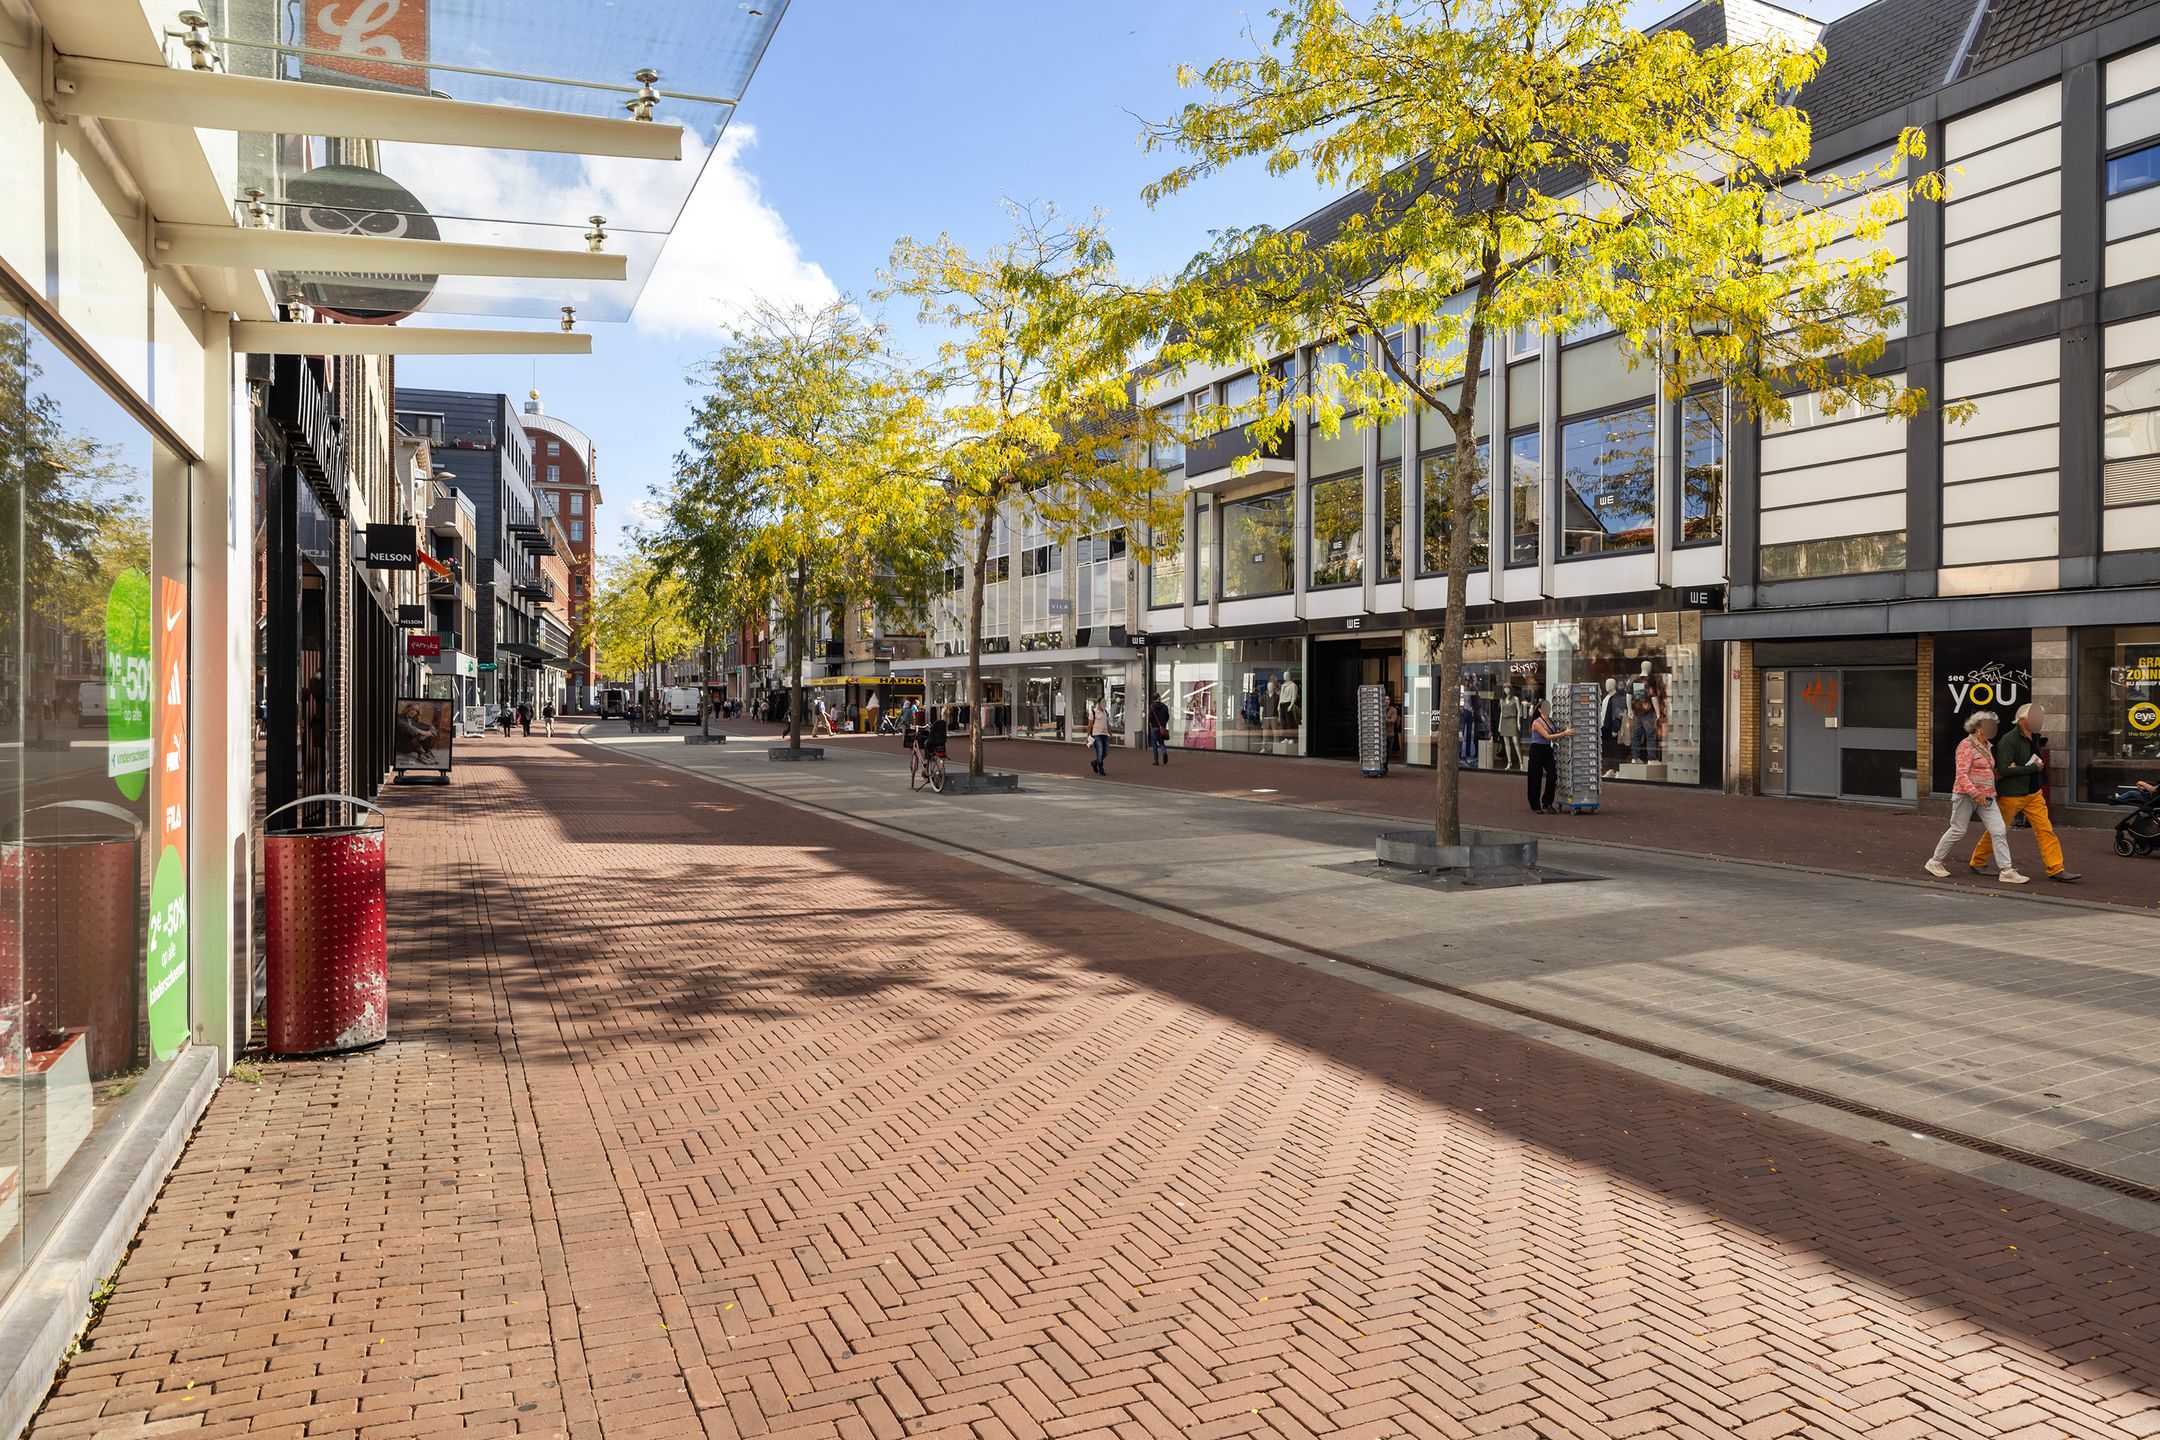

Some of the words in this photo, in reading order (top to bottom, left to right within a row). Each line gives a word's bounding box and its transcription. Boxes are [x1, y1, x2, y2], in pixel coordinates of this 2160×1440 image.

[1600, 495, 1614, 505] WE
[370, 552, 411, 562] NELSON
[1690, 591, 1708, 604] WE
[1346, 618, 1360, 628] WE
[1132, 637, 1145, 645] WE
[2126, 669, 2160, 680] ZONN
[2134, 711, 2156, 722] eye
[166, 803, 182, 834] FILA
[151, 910, 162, 953] 2e
